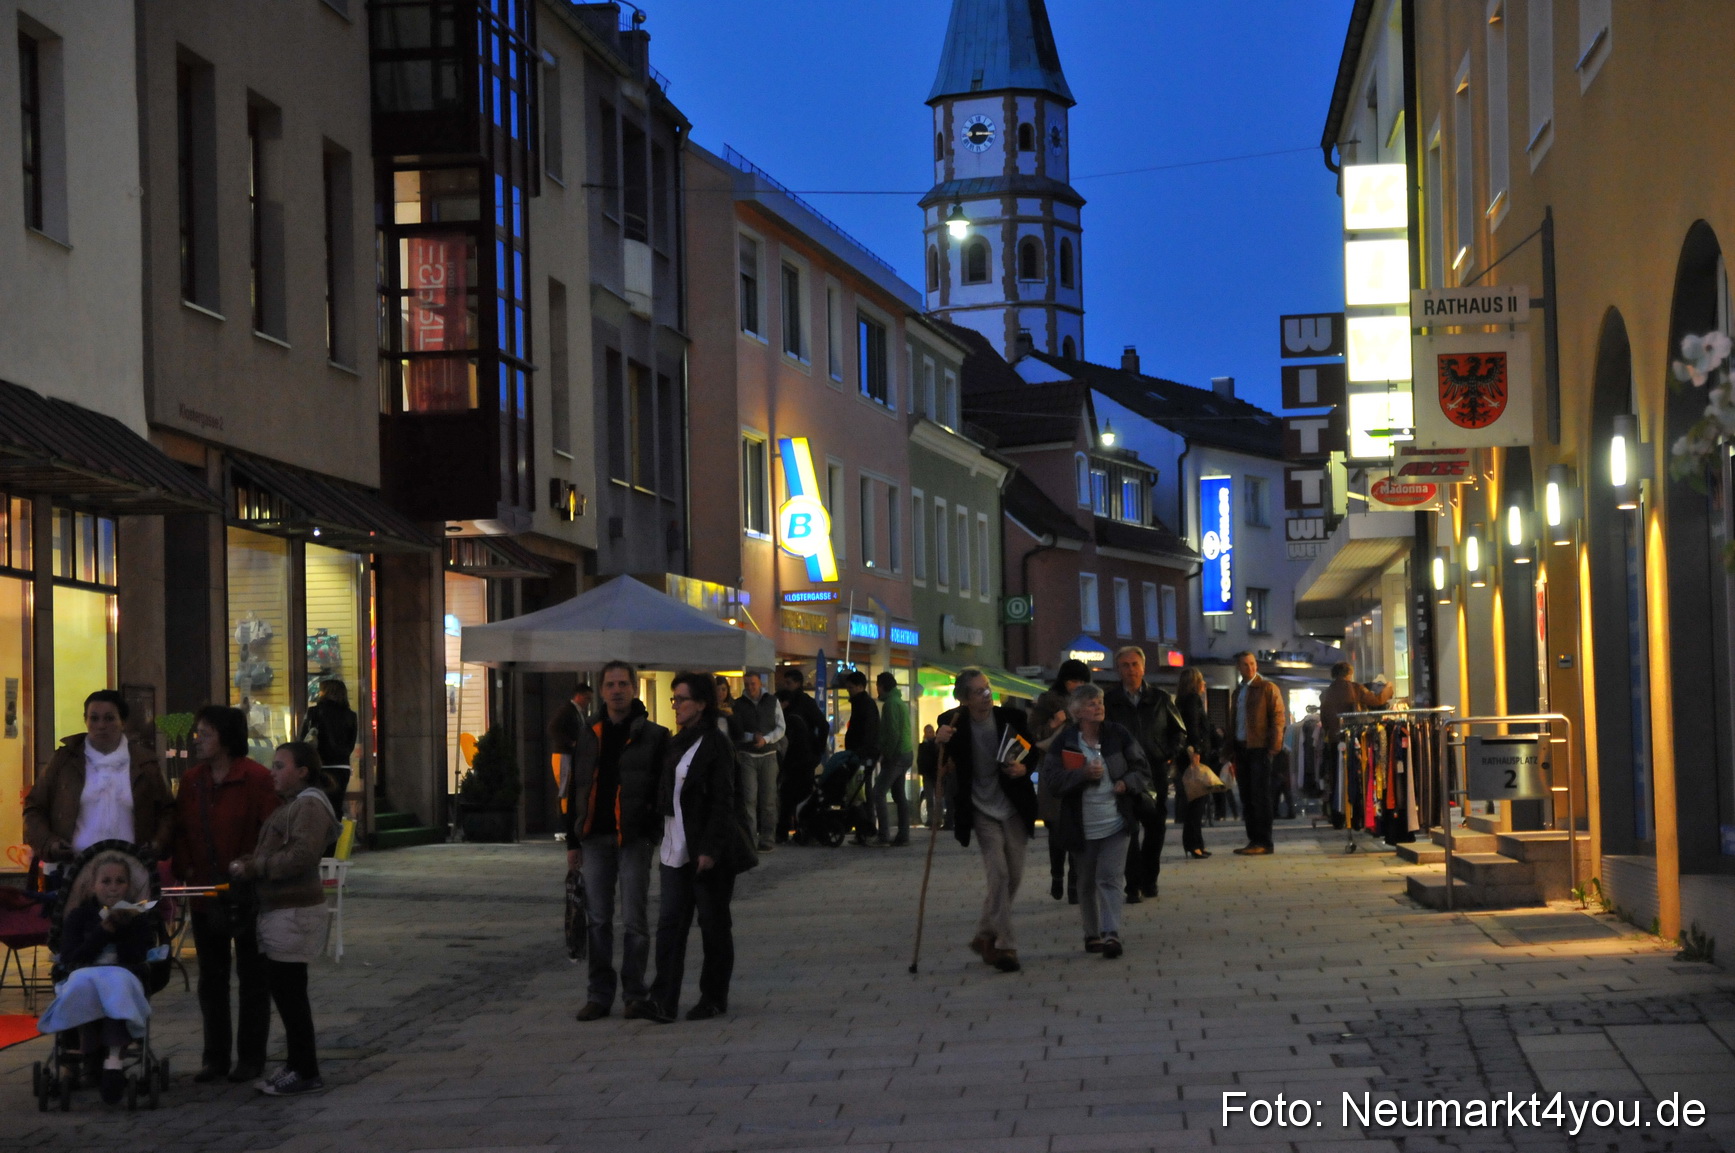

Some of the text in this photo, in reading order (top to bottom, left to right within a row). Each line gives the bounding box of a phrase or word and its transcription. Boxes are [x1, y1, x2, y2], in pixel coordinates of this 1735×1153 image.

[1423, 295, 1518, 315] RATHAUS II
[1284, 317, 1333, 505] WITT
[1380, 482, 1429, 495] Madonna
[787, 512, 812, 539] B
[784, 591, 832, 602] KLOSTERGASSE
[1481, 756, 1538, 765] RATHAUSPLATZ
[1504, 769, 1517, 789] 2
